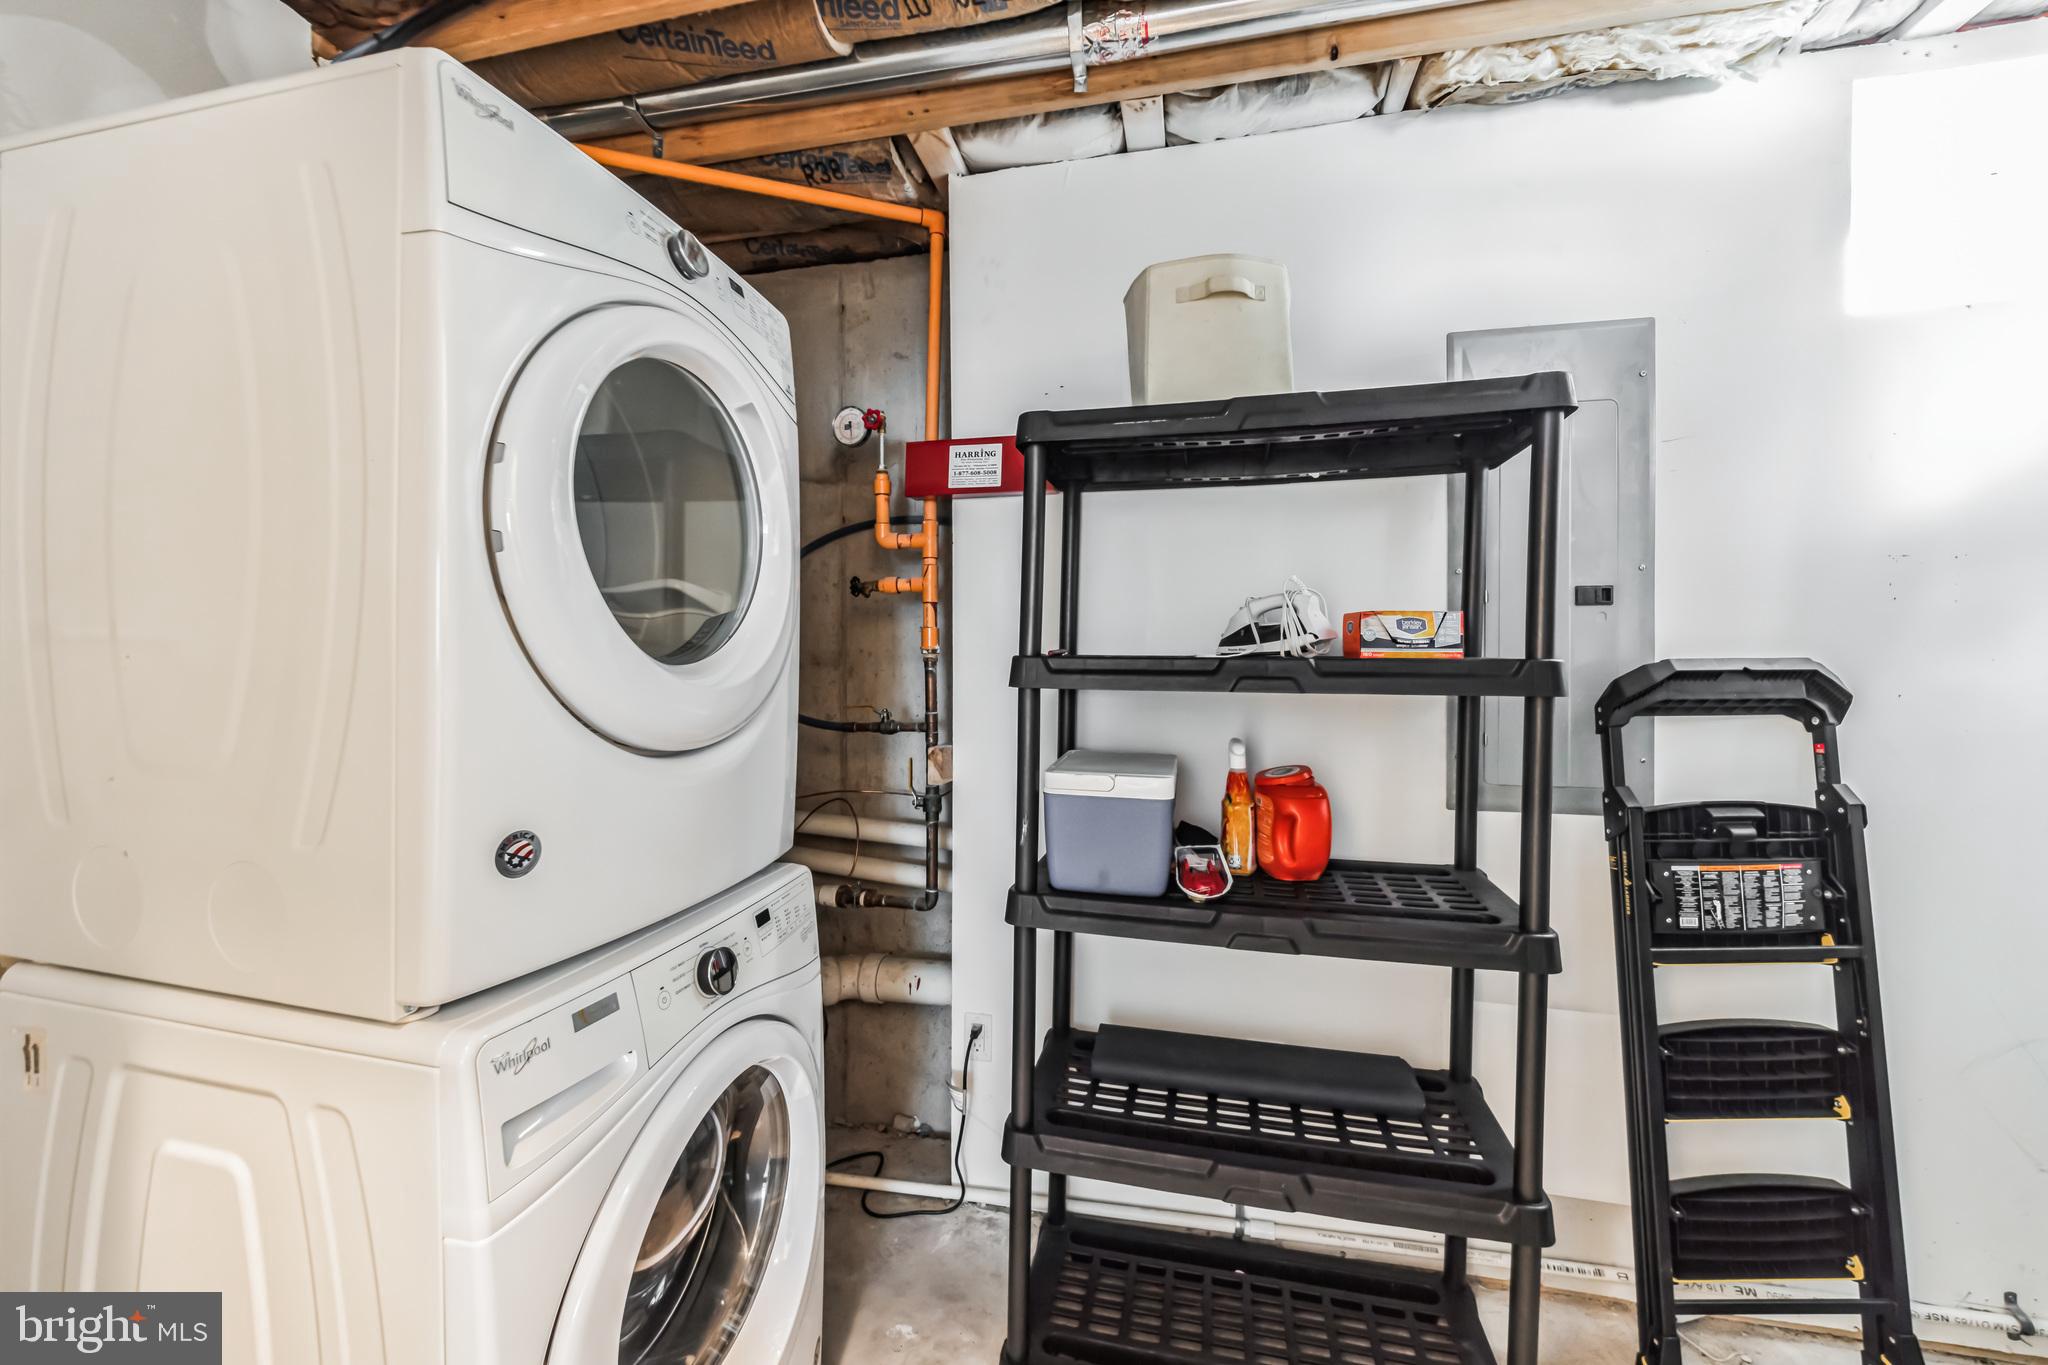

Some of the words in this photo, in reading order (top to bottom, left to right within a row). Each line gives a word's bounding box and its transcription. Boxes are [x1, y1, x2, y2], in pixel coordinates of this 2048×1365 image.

[617, 21, 777, 61] CertainTeed
[955, 448, 997, 458] HARRING
[491, 1036, 551, 1075] Whirlpool
